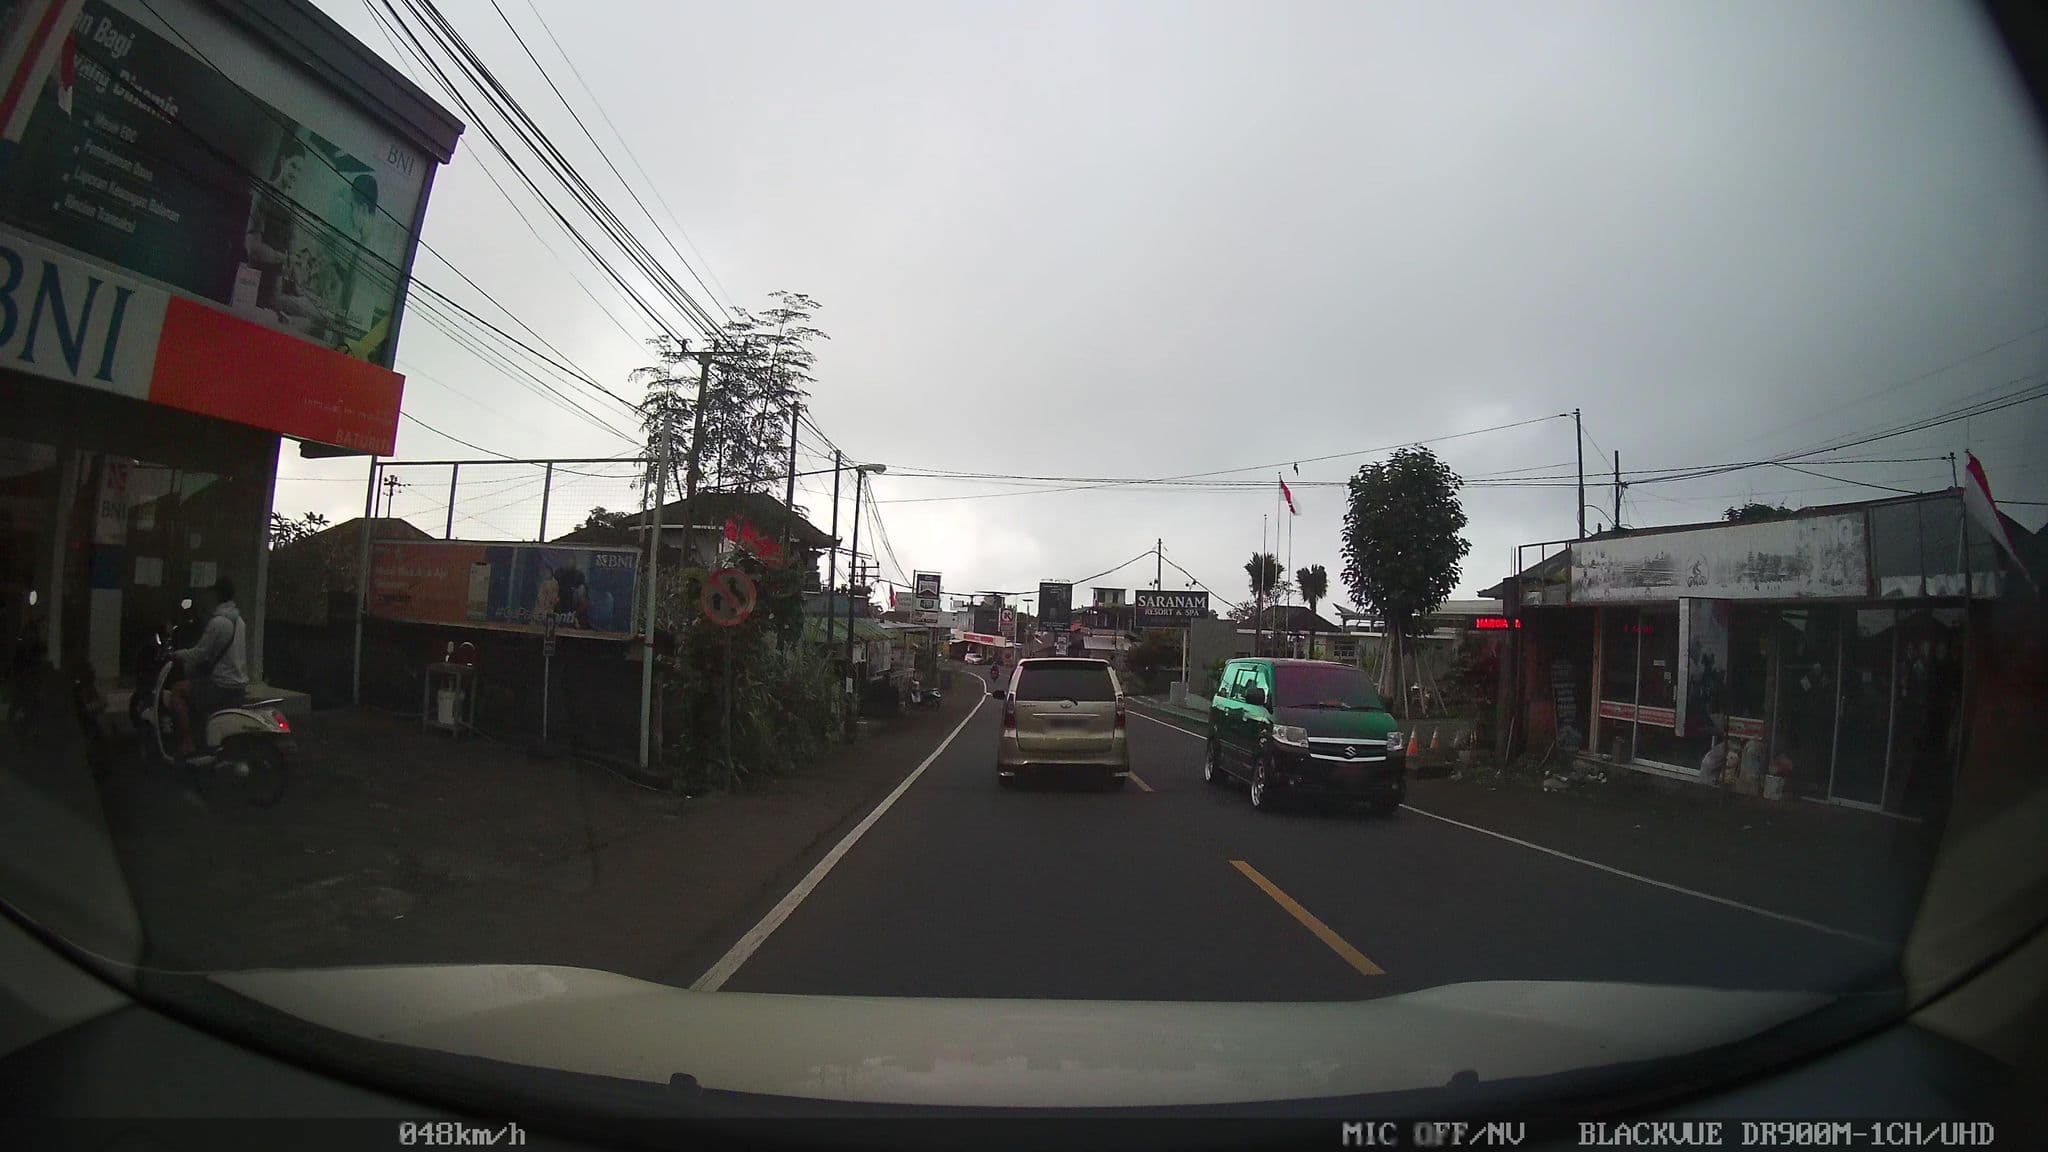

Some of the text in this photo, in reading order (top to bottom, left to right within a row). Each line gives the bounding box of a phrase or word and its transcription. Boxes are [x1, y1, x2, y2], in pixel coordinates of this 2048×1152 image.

[94, 16, 136, 59] Bagi
[387, 144, 416, 176] BNI
[0, 247, 135, 382] BNI
[1138, 595, 1206, 608] SARANAM
[1145, 608, 1173, 616] RESORT
[1185, 609, 1199, 617] SPA
